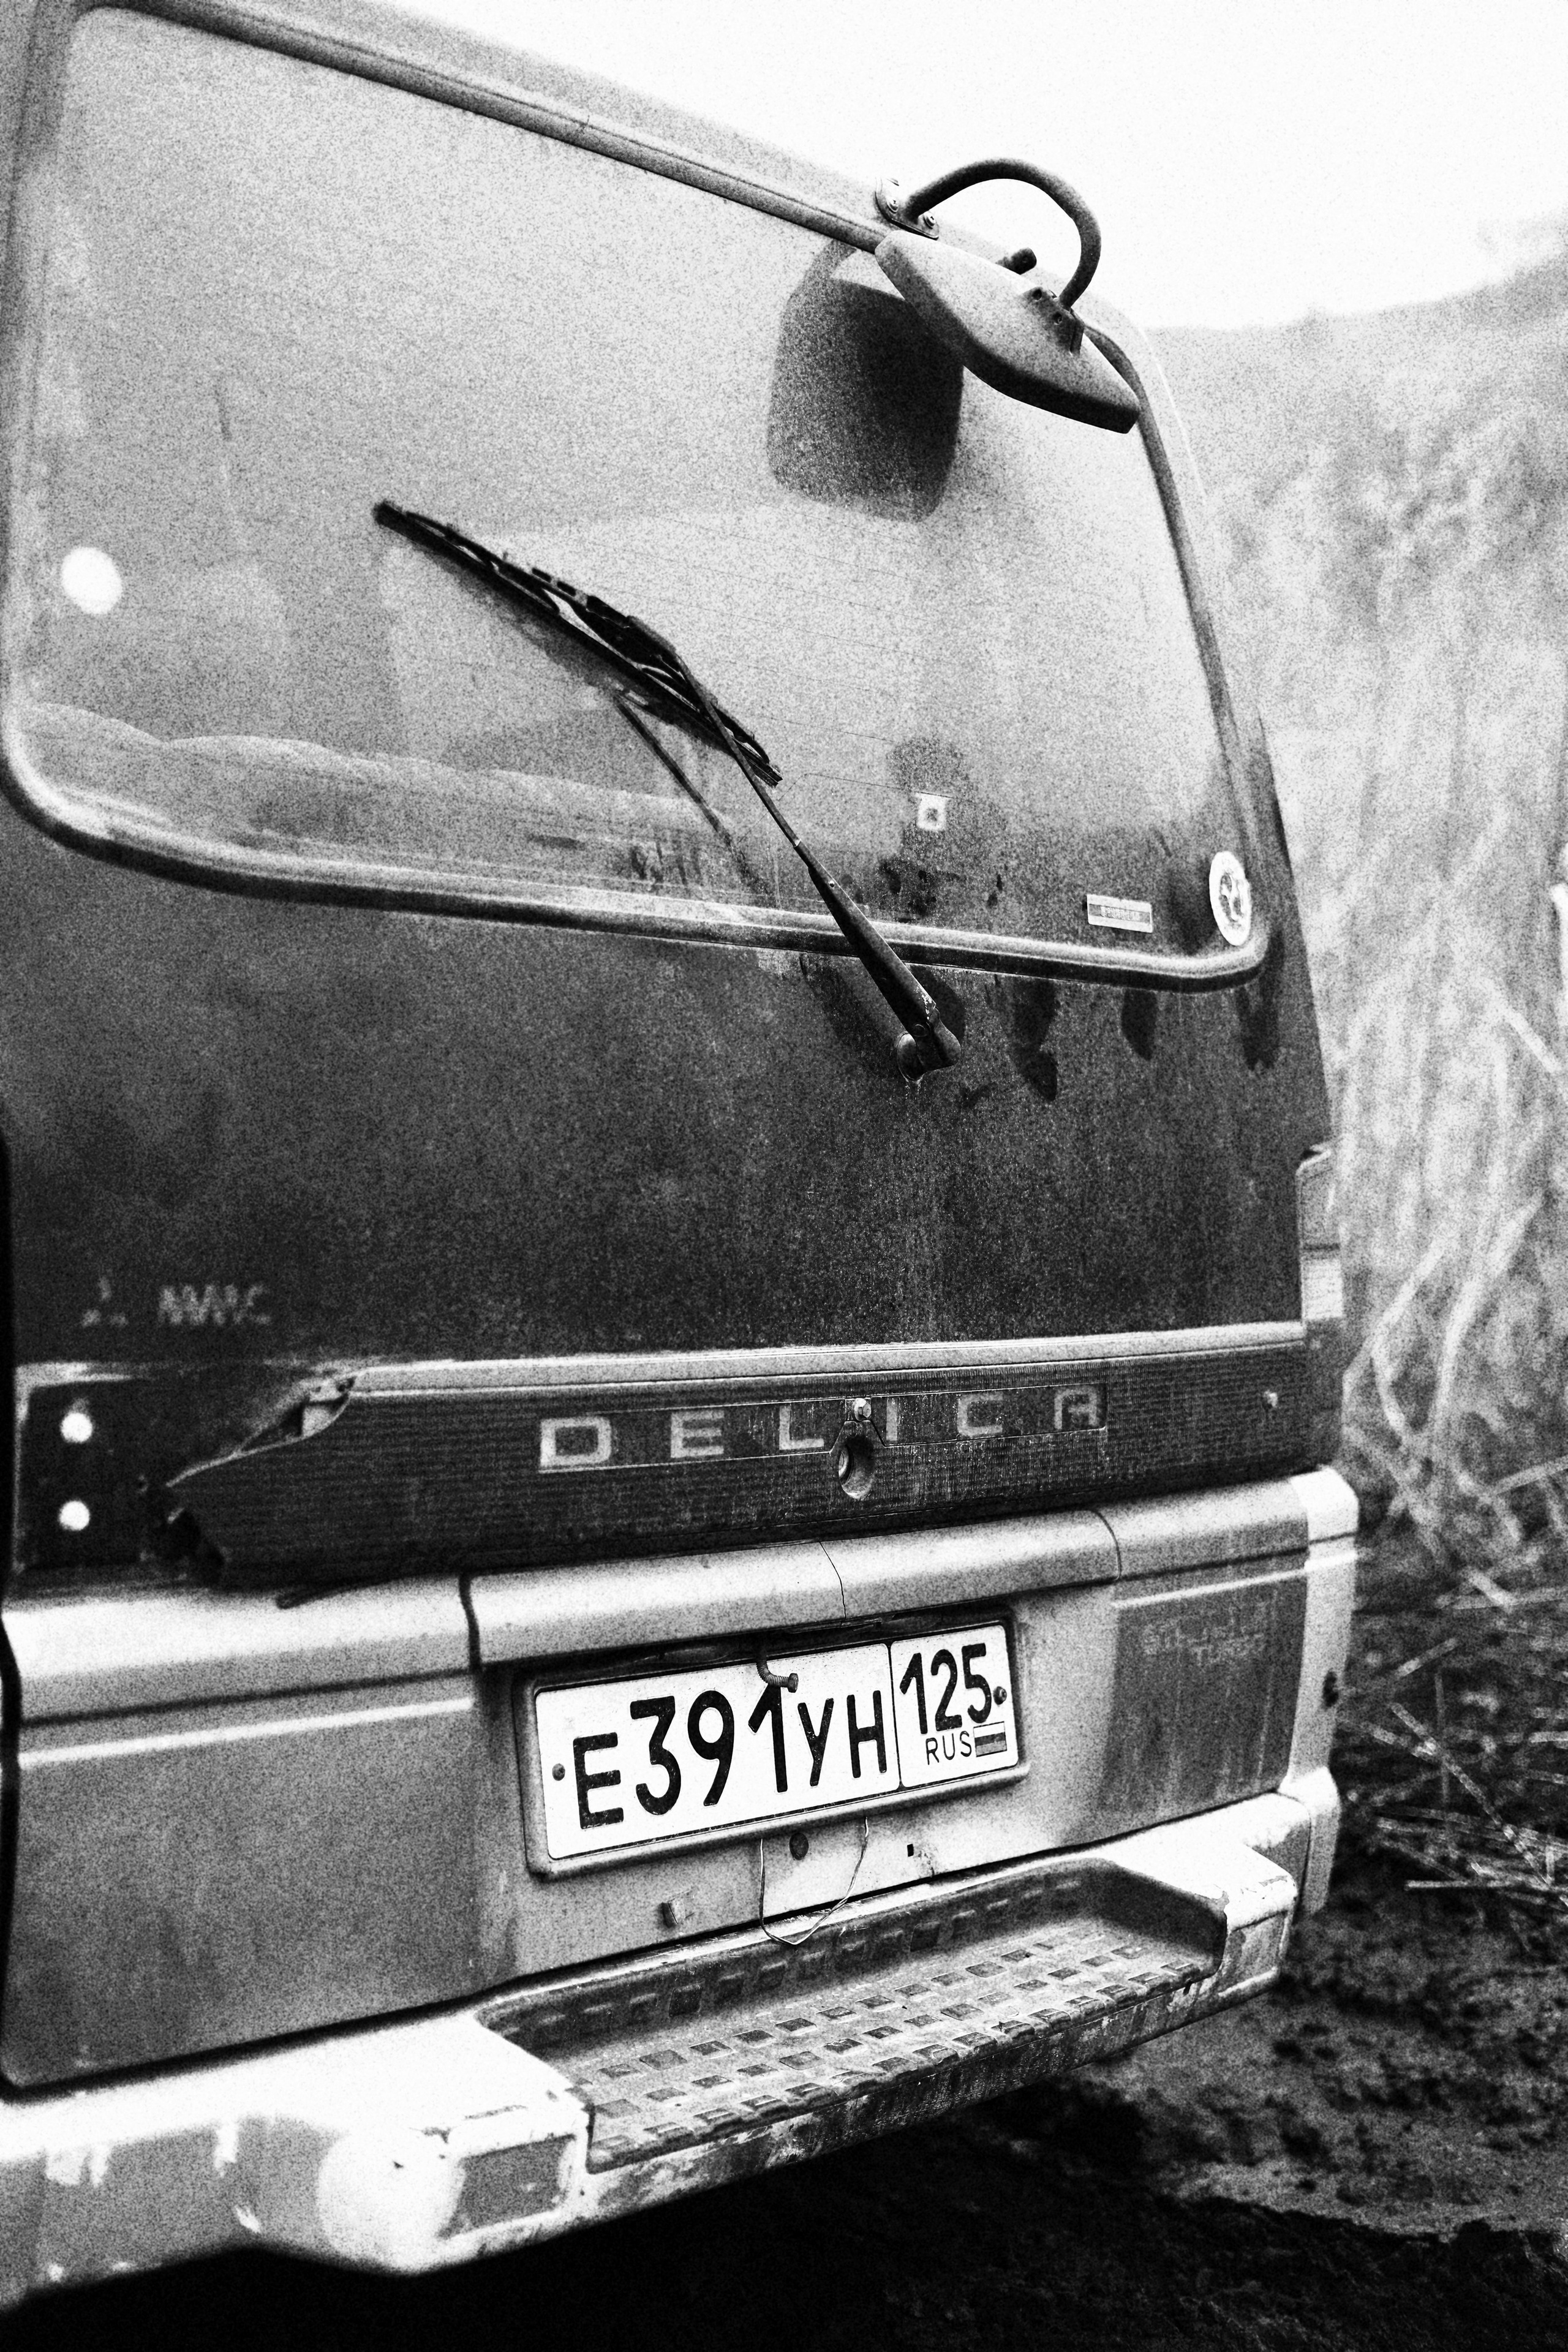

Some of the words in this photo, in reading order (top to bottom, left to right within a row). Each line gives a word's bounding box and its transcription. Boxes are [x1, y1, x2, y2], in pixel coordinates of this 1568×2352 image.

[540, 1384, 1101, 1468] DELICA
[899, 1643, 992, 1735] 125
[926, 1733, 973, 1766] RUS
